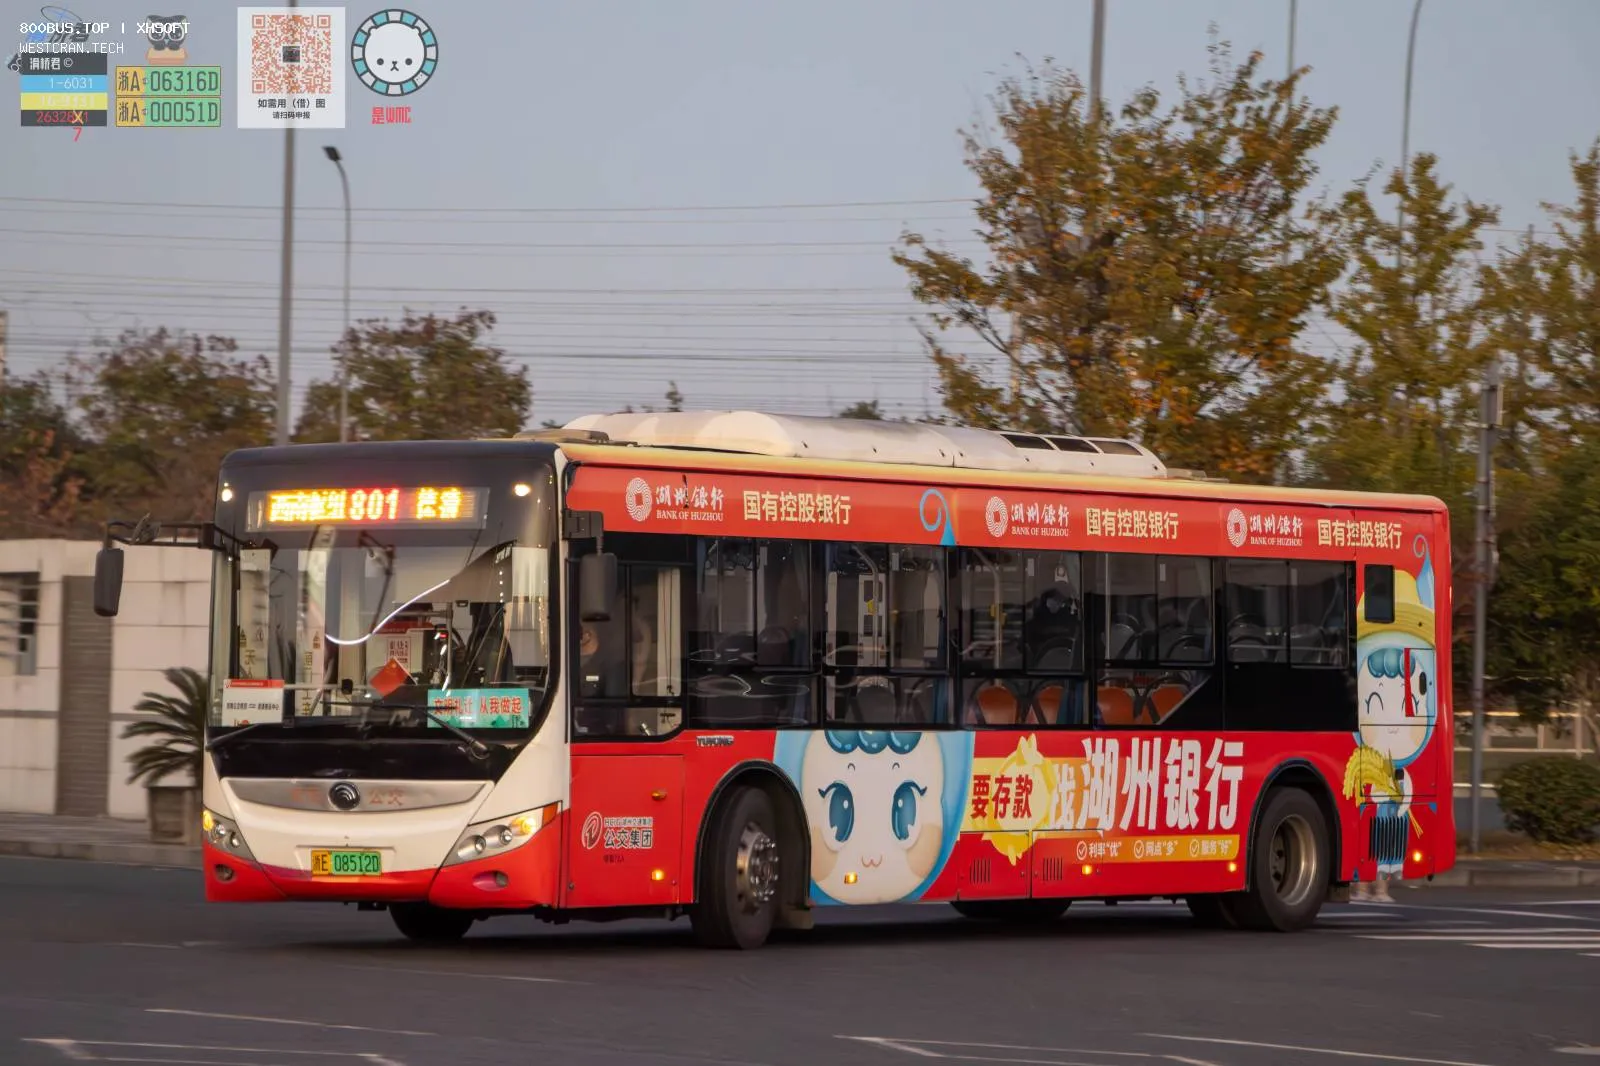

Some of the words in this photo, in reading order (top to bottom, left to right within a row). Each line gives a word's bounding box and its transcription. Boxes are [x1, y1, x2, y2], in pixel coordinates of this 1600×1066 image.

[349, 489, 400, 521] 801
[656, 511, 677, 519] BANK
[690, 512, 724, 522] HUZHOU
[743, 490, 851, 525] 国有控股银行
[1011, 526, 1029, 535] BANK
[1031, 527, 1040, 535] OF
[1041, 527, 1069, 537] HUZHOU
[1086, 507, 1179, 540] 国有控股银行
[1317, 518, 1402, 550] 国有控股银行
[1250, 536, 1266, 545] BANK
[1268, 537, 1276, 545] OF
[1277, 537, 1303, 547] HUZHOU
[480, 697, 522, 715] 从我做起
[970, 774, 1033, 819] 要存款
[604, 829, 653, 848] 公交集团
